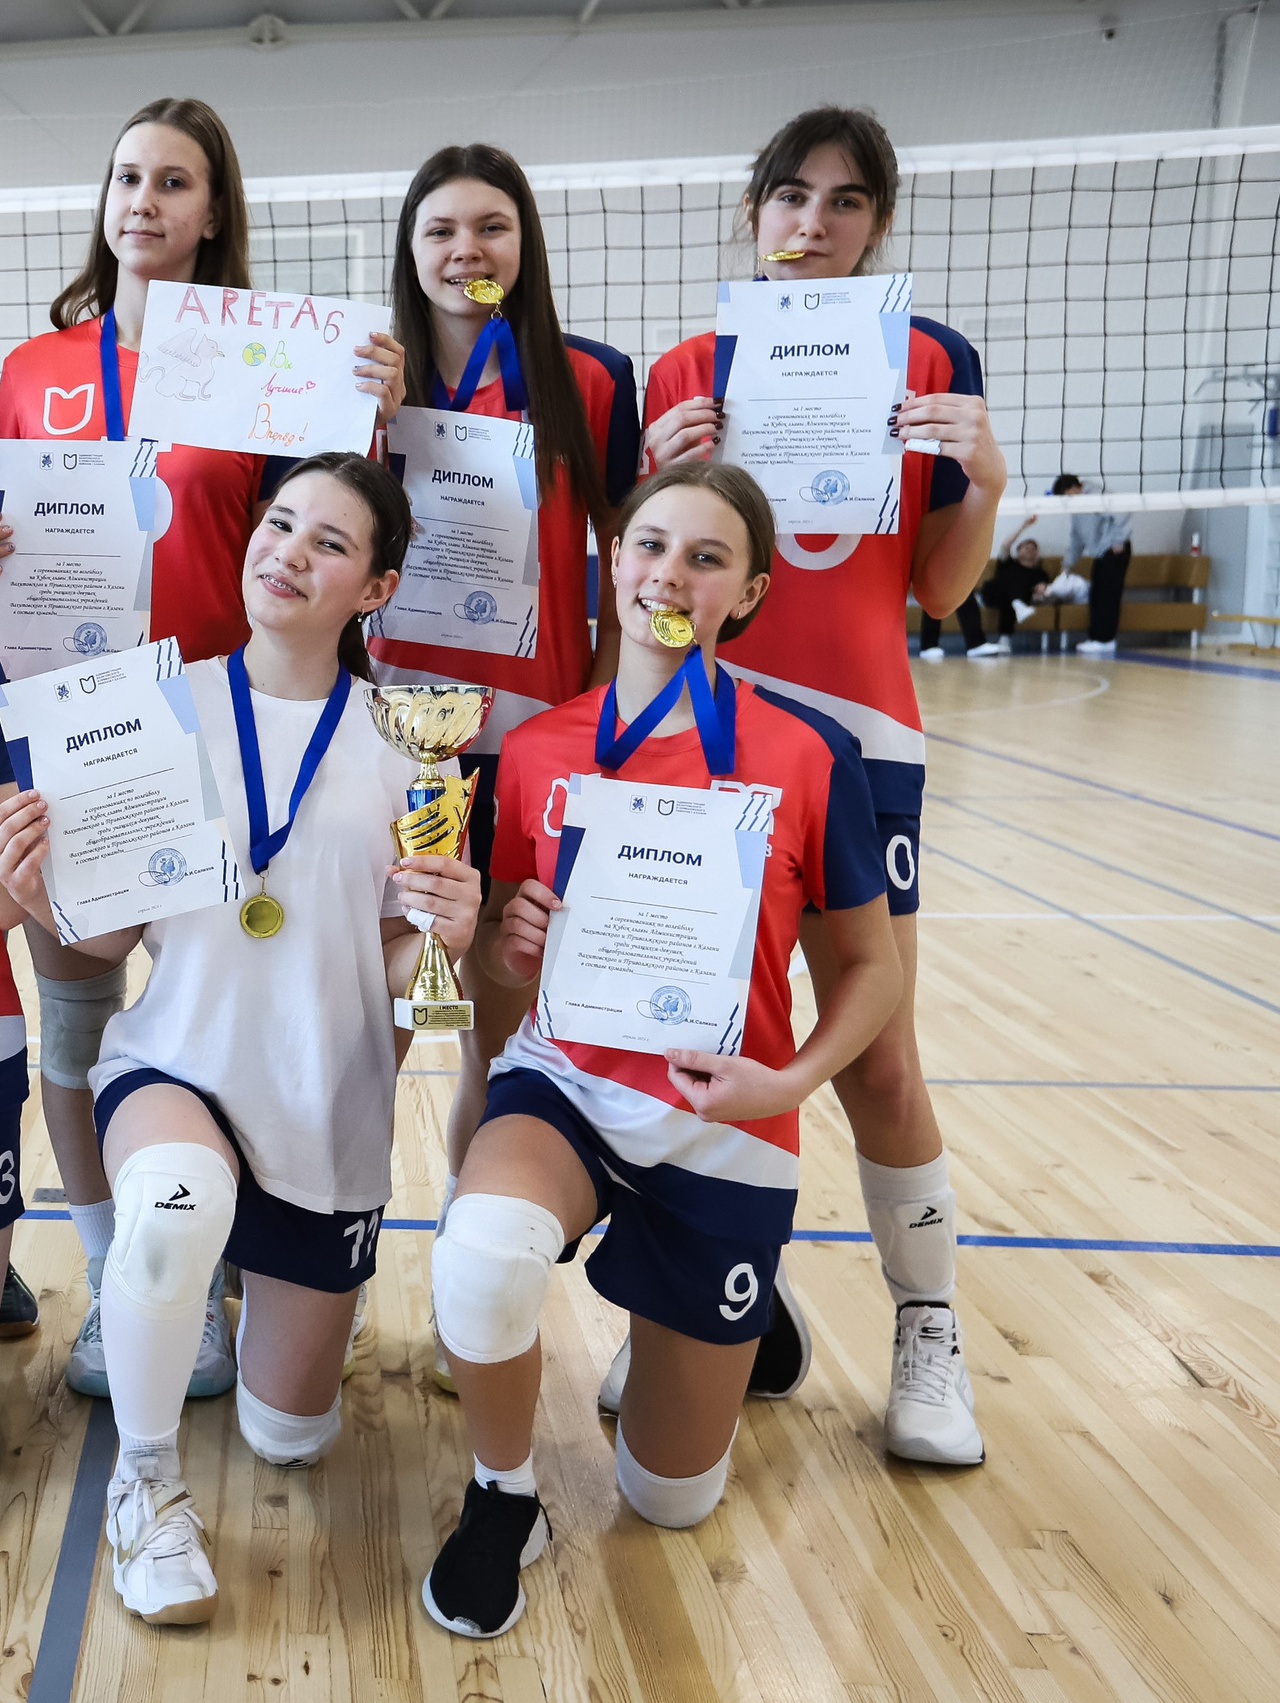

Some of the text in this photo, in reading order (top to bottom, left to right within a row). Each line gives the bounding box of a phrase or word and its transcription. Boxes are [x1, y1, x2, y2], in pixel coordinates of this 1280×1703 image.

[771, 344, 849, 360] ДИПЛОМ
[432, 469, 494, 489] ДИПЛОМ
[441, 495, 485, 506] НАГРАЖДАЕТСЯ
[34, 502, 104, 516] ДИПЛОМ
[67, 719, 141, 752] ДИПЛОМ
[84, 748, 138, 767] НАГРАЖДАЕТСЯ
[618, 846, 702, 866] ДИПЛОМ
[629, 873, 688, 885] НАГРАЖДАЕТСЯ
[154, 1201, 196, 1212] DEMIX
[908, 1216, 944, 1229] DEMIX
[719, 1262, 758, 1321] 9
